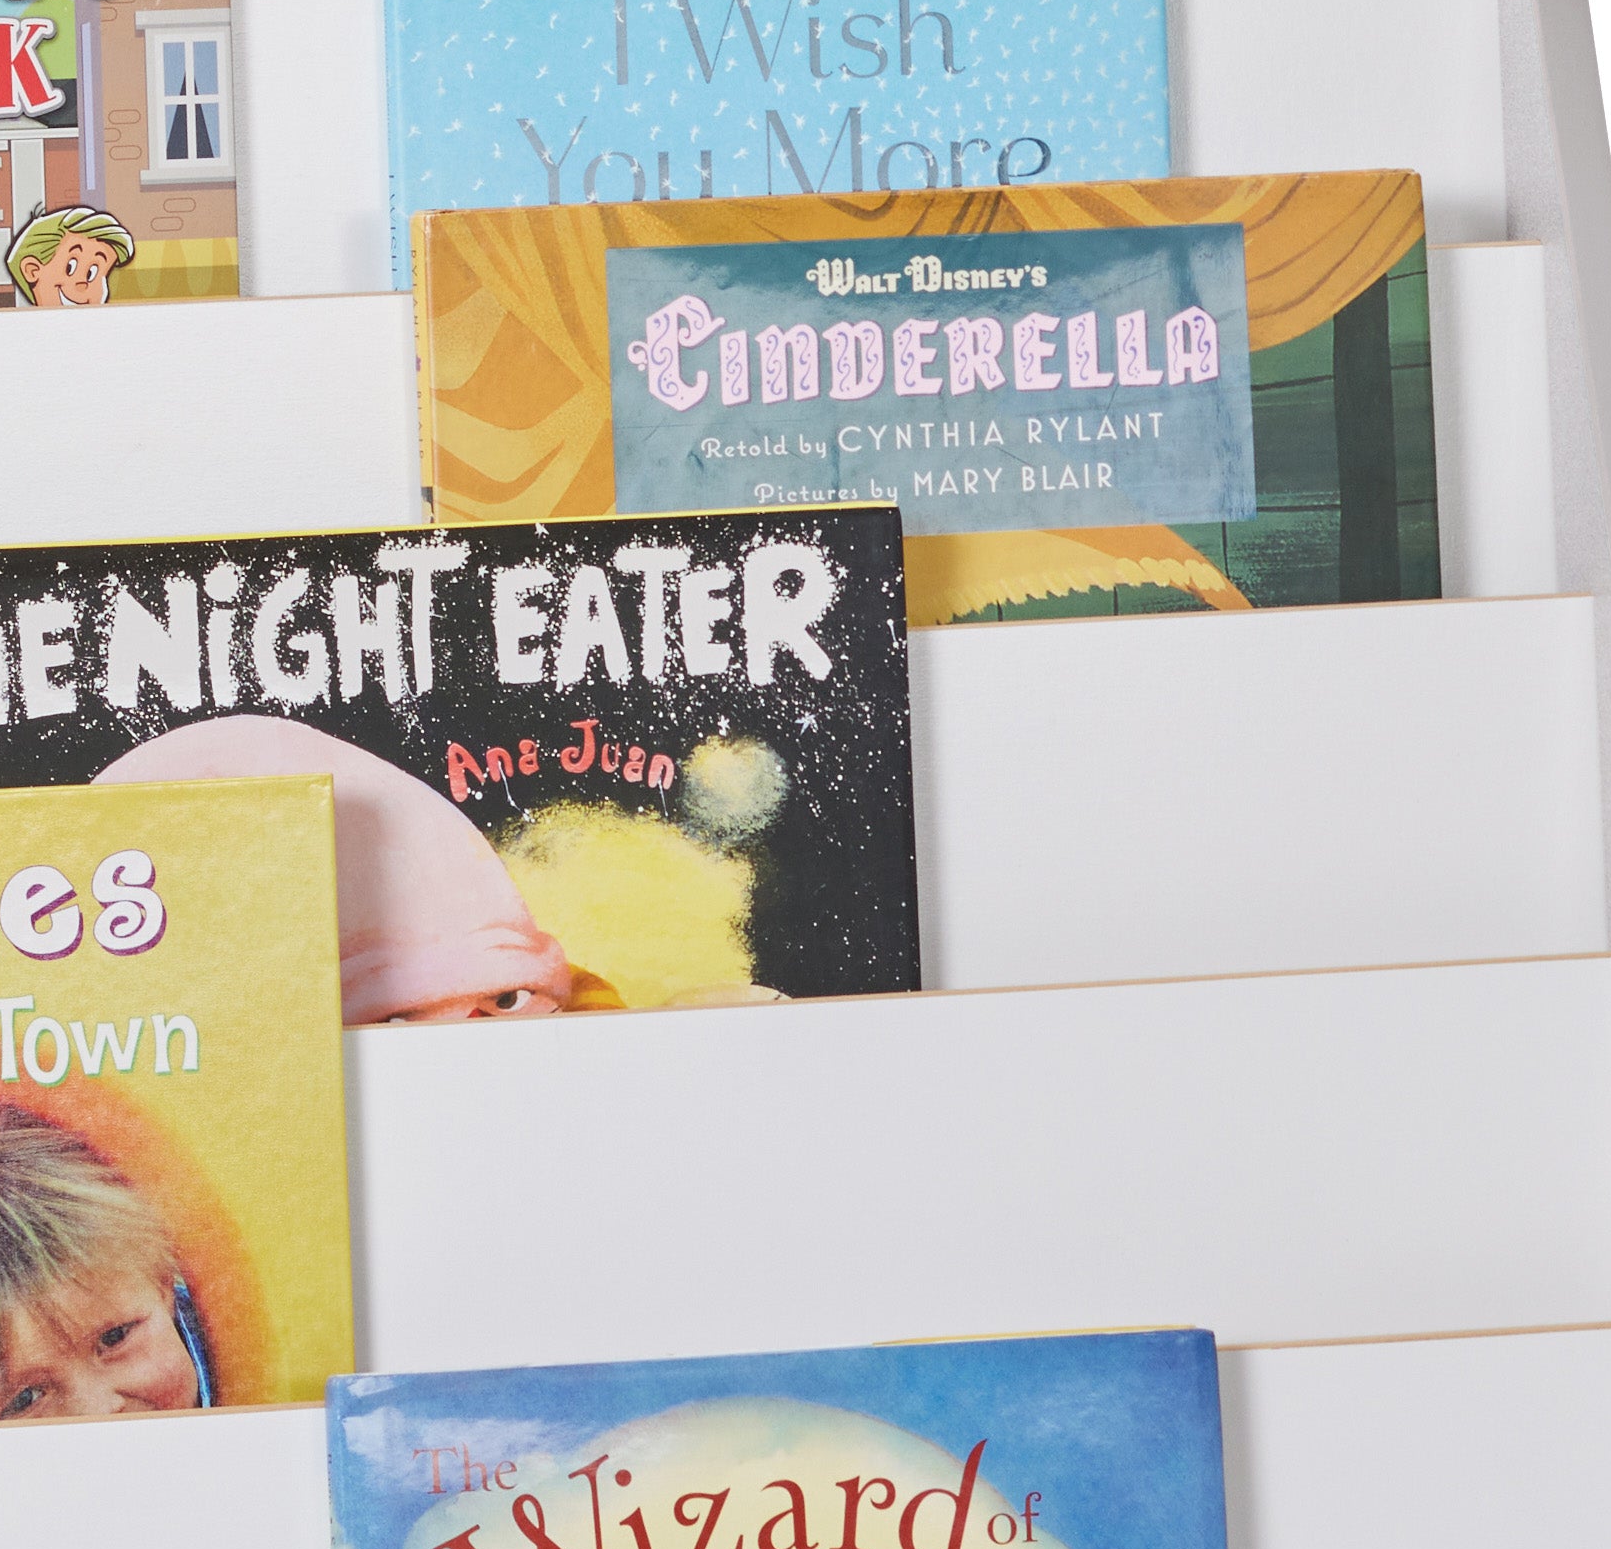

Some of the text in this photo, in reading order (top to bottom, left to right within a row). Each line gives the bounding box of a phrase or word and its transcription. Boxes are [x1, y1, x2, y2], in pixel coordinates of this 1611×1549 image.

[516, 107, 1052, 205] You More
[627, 293, 1221, 412] CINDERELLA
[700, 411, 1167, 461] Retold by CYNTHIA RYLANT
[754, 462, 1115, 504] Pictures by MARY BLAIR
[497, 540, 834, 691] EATER
[448, 719, 675, 802] Ana Juan
[413, 1446, 518, 1495] The
[986, 1492, 1041, 1545] of
